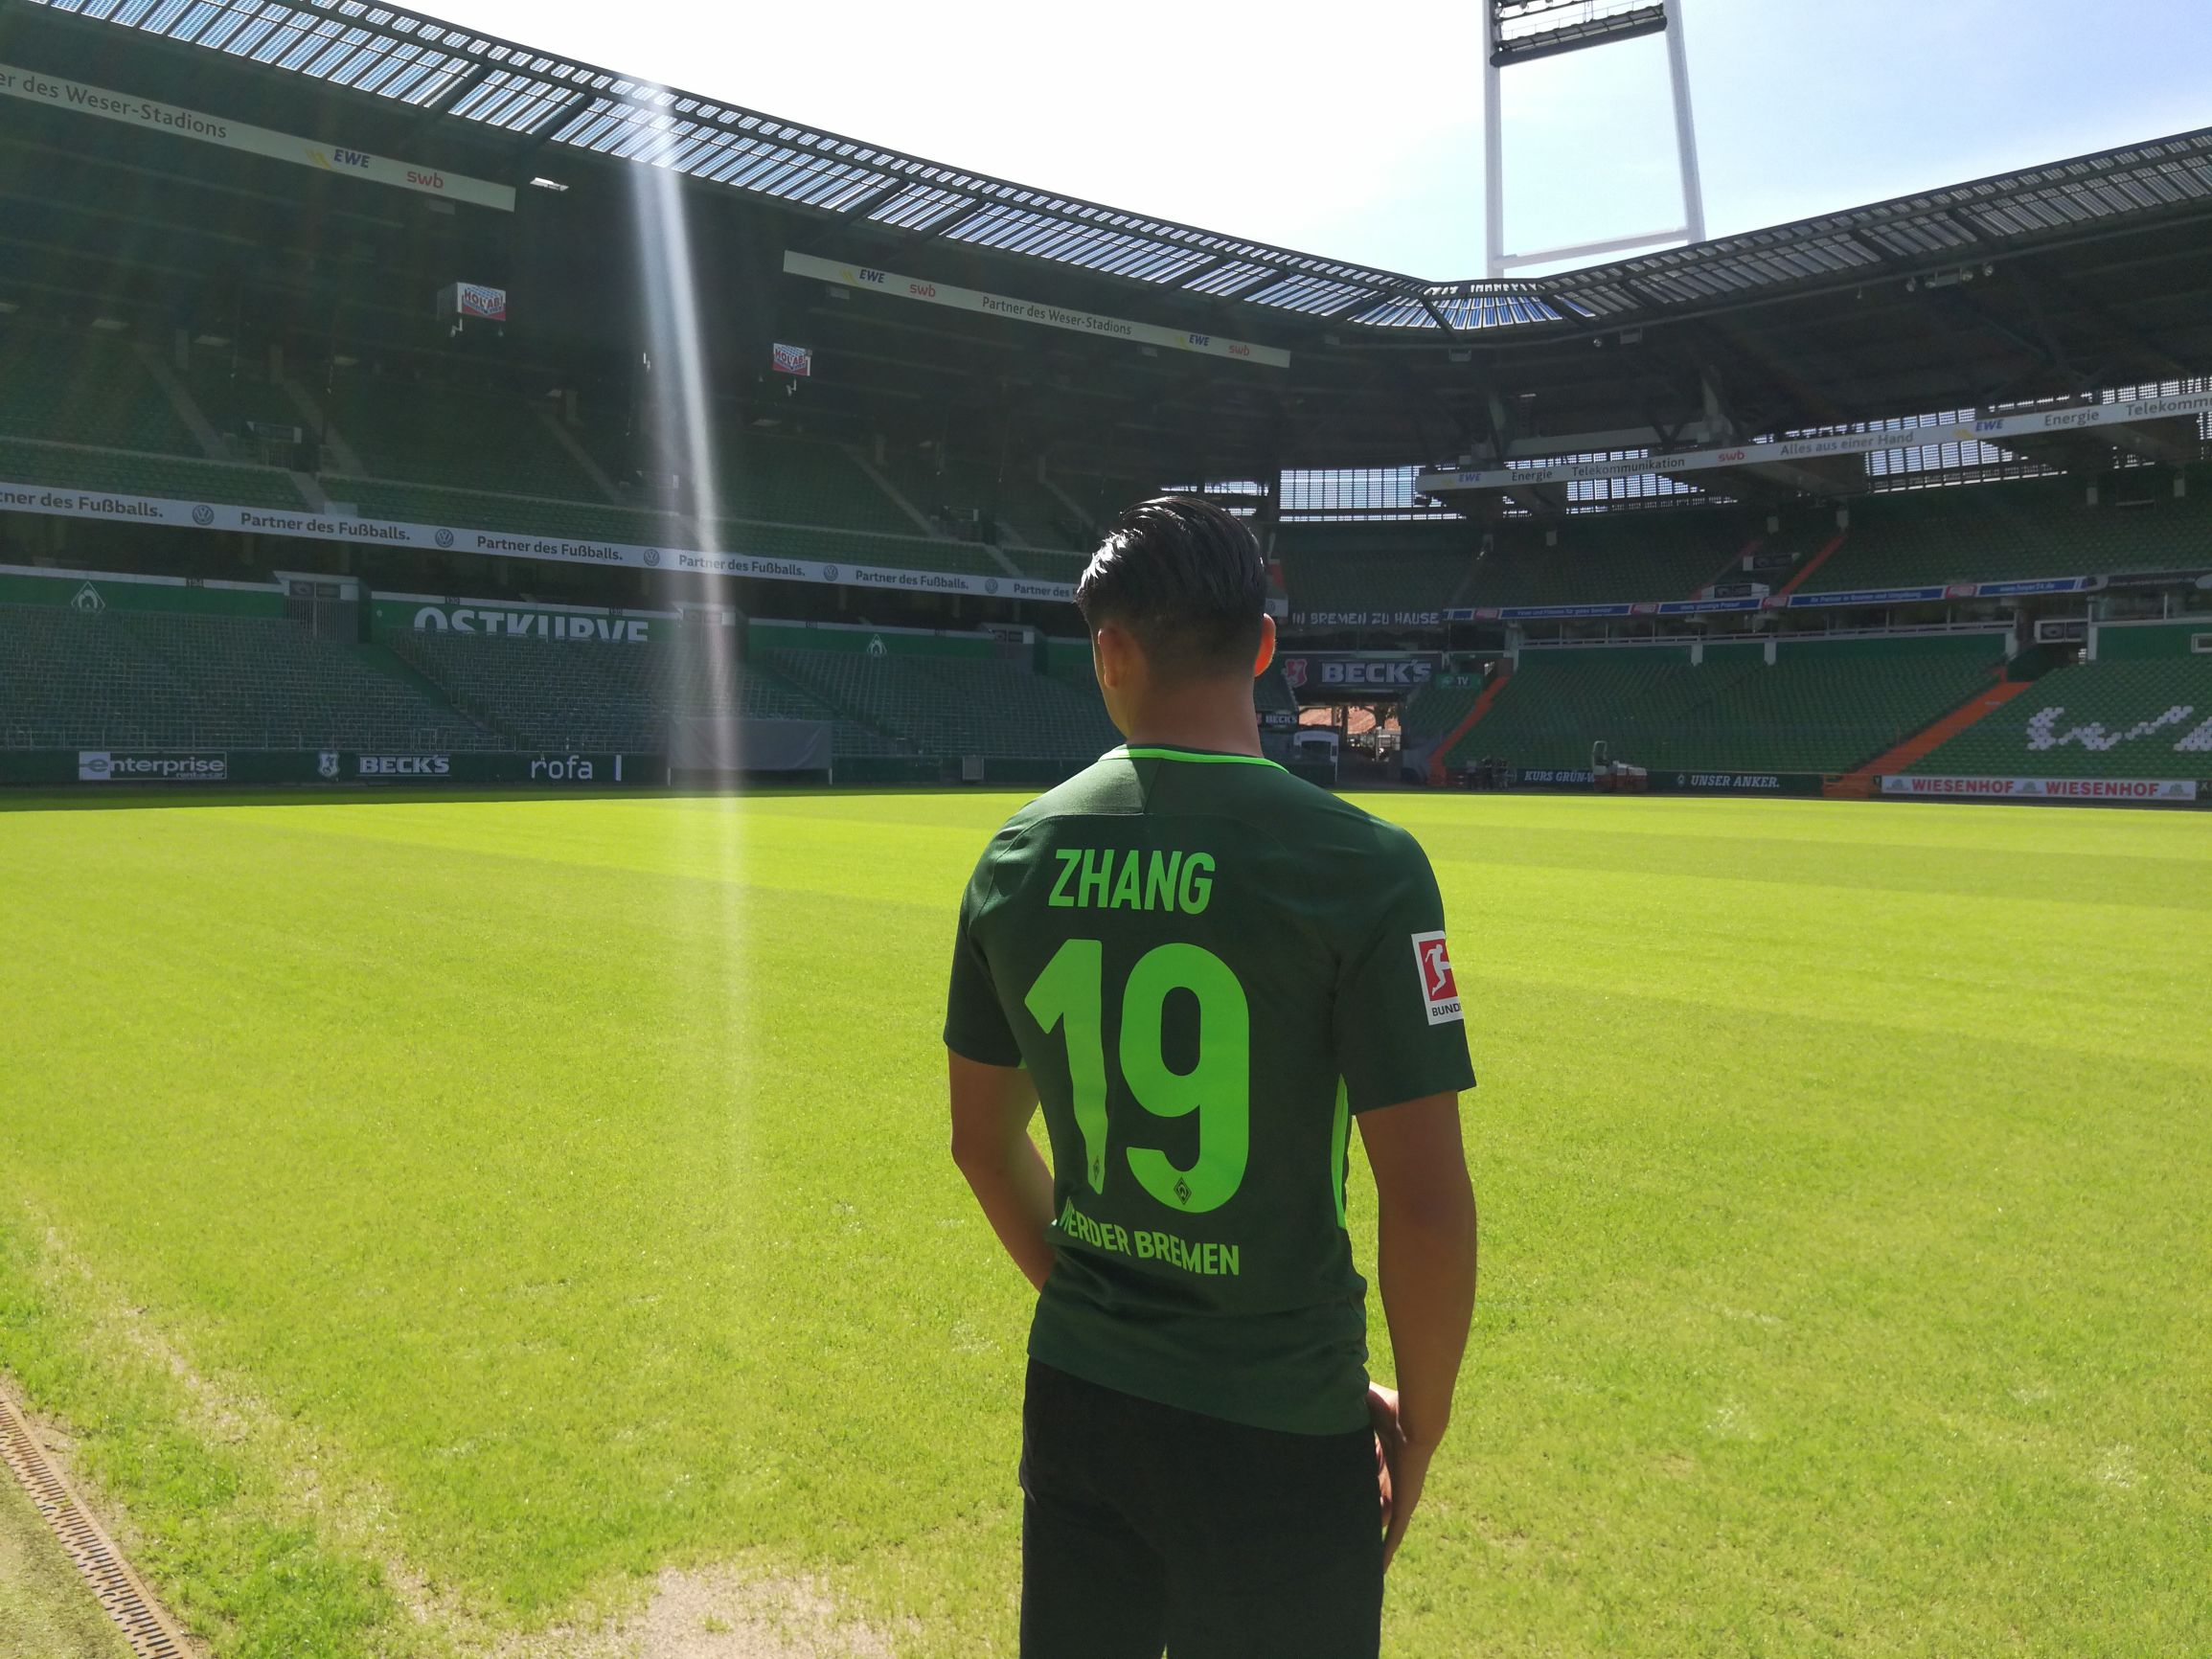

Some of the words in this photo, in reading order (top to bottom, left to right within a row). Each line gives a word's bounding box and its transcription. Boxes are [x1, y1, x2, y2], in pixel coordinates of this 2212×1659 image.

[23, 76, 59, 98] des
[65, 85, 227, 138] Weser-Stadions
[333, 149, 371, 169] EWE
[406, 170, 445, 189] swb
[859, 269, 885, 284] EWE
[909, 284, 936, 298] swb
[982, 296, 1025, 316] Partner
[1026, 305, 1046, 320] des
[1048, 309, 1132, 335] Weser-Stadions
[1188, 334, 1210, 348] EWE
[1974, 419, 2004, 432] EWE
[2044, 411, 2100, 428] Energie
[1780, 443, 1813, 457] Alles
[1815, 441, 1837, 452] aus
[1840, 437, 1874, 450] einer
[1878, 431, 1914, 446] Hand
[1717, 449, 1745, 464] swb
[1512, 469, 1553, 486] Energie
[1571, 457, 1685, 478] Telekommunikation
[40, 492, 74, 509] des
[79, 496, 164, 518] Fußballs.
[240, 512, 303, 531] Partner
[307, 519, 334, 534] des
[338, 522, 411, 540] Fußballs.
[477, 535, 530, 552] Partner
[534, 541, 558, 555] des
[561, 544, 623, 560] Fußballs.
[679, 555, 725, 570] Partner
[727, 558, 749, 572] des
[751, 561, 806, 577] Fußballs.
[855, 570, 896, 583] Partner
[899, 574, 918, 586] des
[921, 576, 969, 590] Fußballs.
[1014, 583, 1051, 596] Partner
[1053, 586, 1070, 597] des
[1292, 611, 1306, 625] IN
[1311, 611, 1367, 625] BREMEN
[1372, 612, 1390, 625] ZU
[1395, 612, 1440, 625] HAUSE
[1321, 659, 1432, 683] BECK'S
[86, 757, 224, 776] enterprise
[359, 755, 450, 774] BECK'S
[530, 755, 593, 780] rofa
[1524, 770, 1553, 782] KURS
[1690, 774, 1731, 787] UNSER
[1733, 775, 1780, 788] ANKER.
[1911, 778, 2015, 794] WIESENHOF
[2045, 781, 2160, 796] WIESENHOF
[1048, 849, 1216, 915] ZHANG
[1431, 1002, 1462, 1016] BUND
[1024, 938, 1249, 1214] 19
[1134, 1230, 1239, 1276] BREMEN
